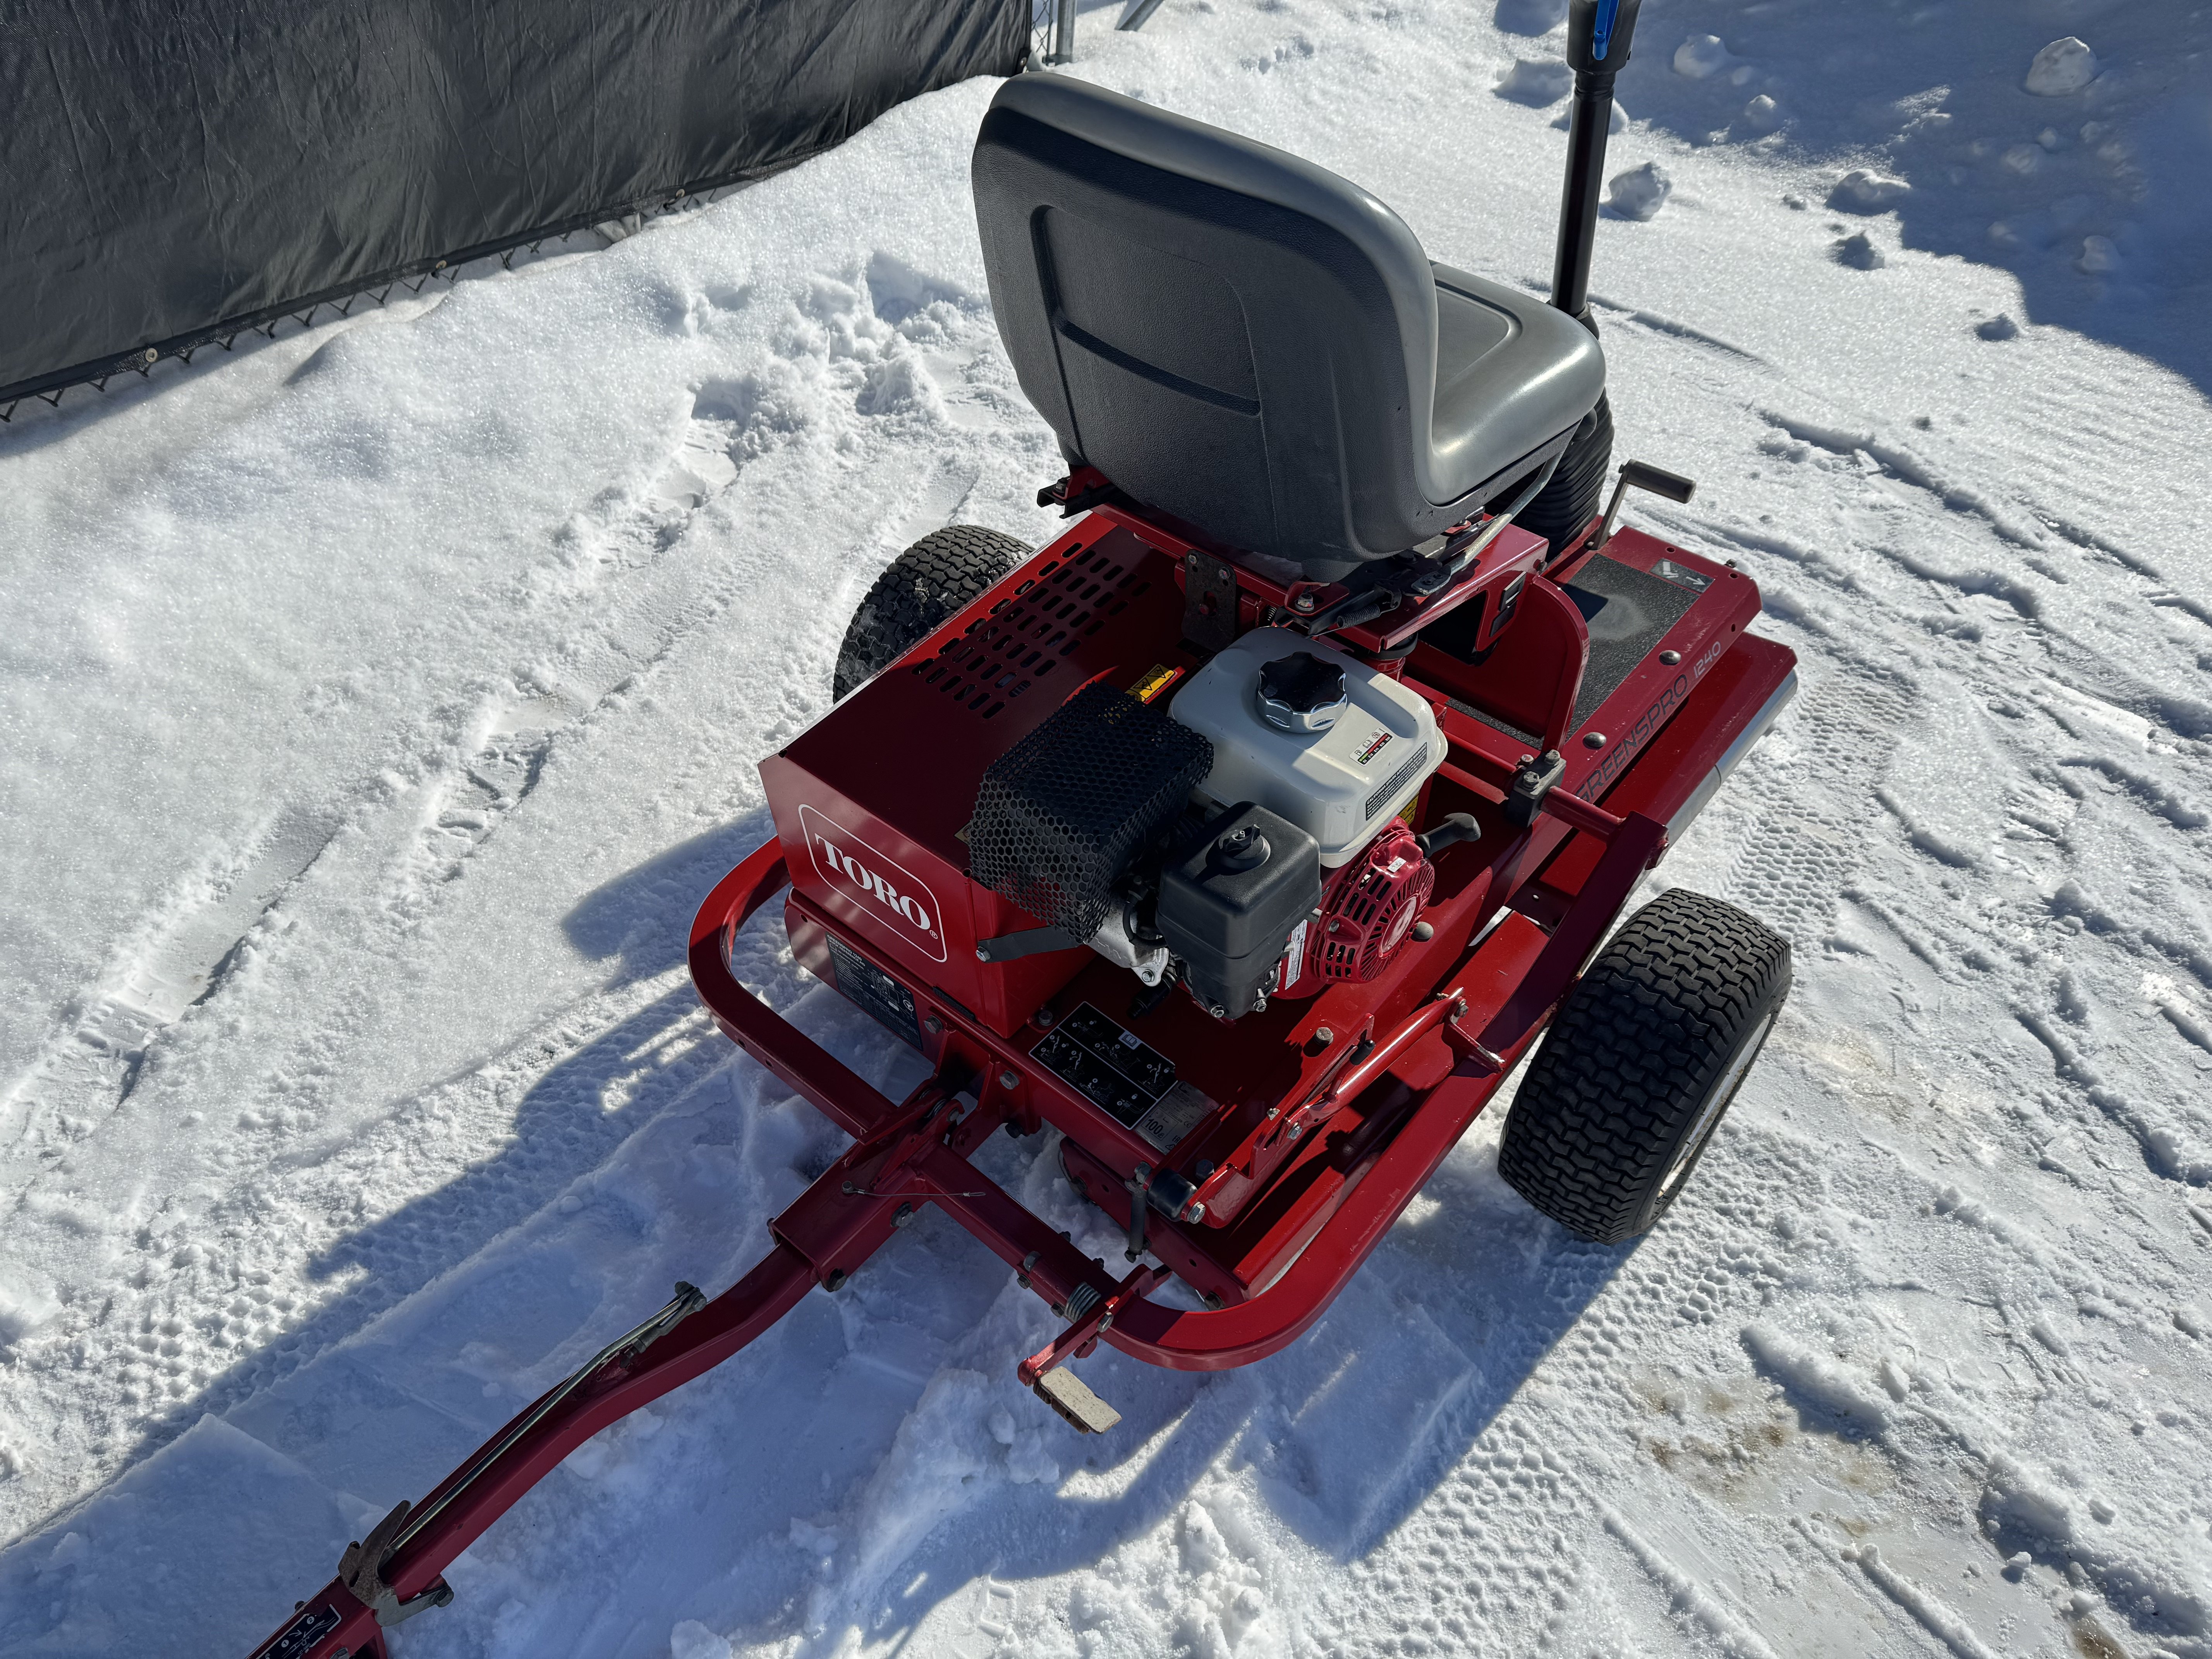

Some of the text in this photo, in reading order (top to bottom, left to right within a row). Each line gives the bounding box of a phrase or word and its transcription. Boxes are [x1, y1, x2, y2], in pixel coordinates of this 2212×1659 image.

[1576, 641, 1721, 802] GREENSPRO 1240
[1367, 785, 1386, 804] CALIFORNIA
[1386, 774, 1396, 787] SPARK
[814, 833, 930, 930] TORO
[1145, 1118, 1163, 1135] 100
